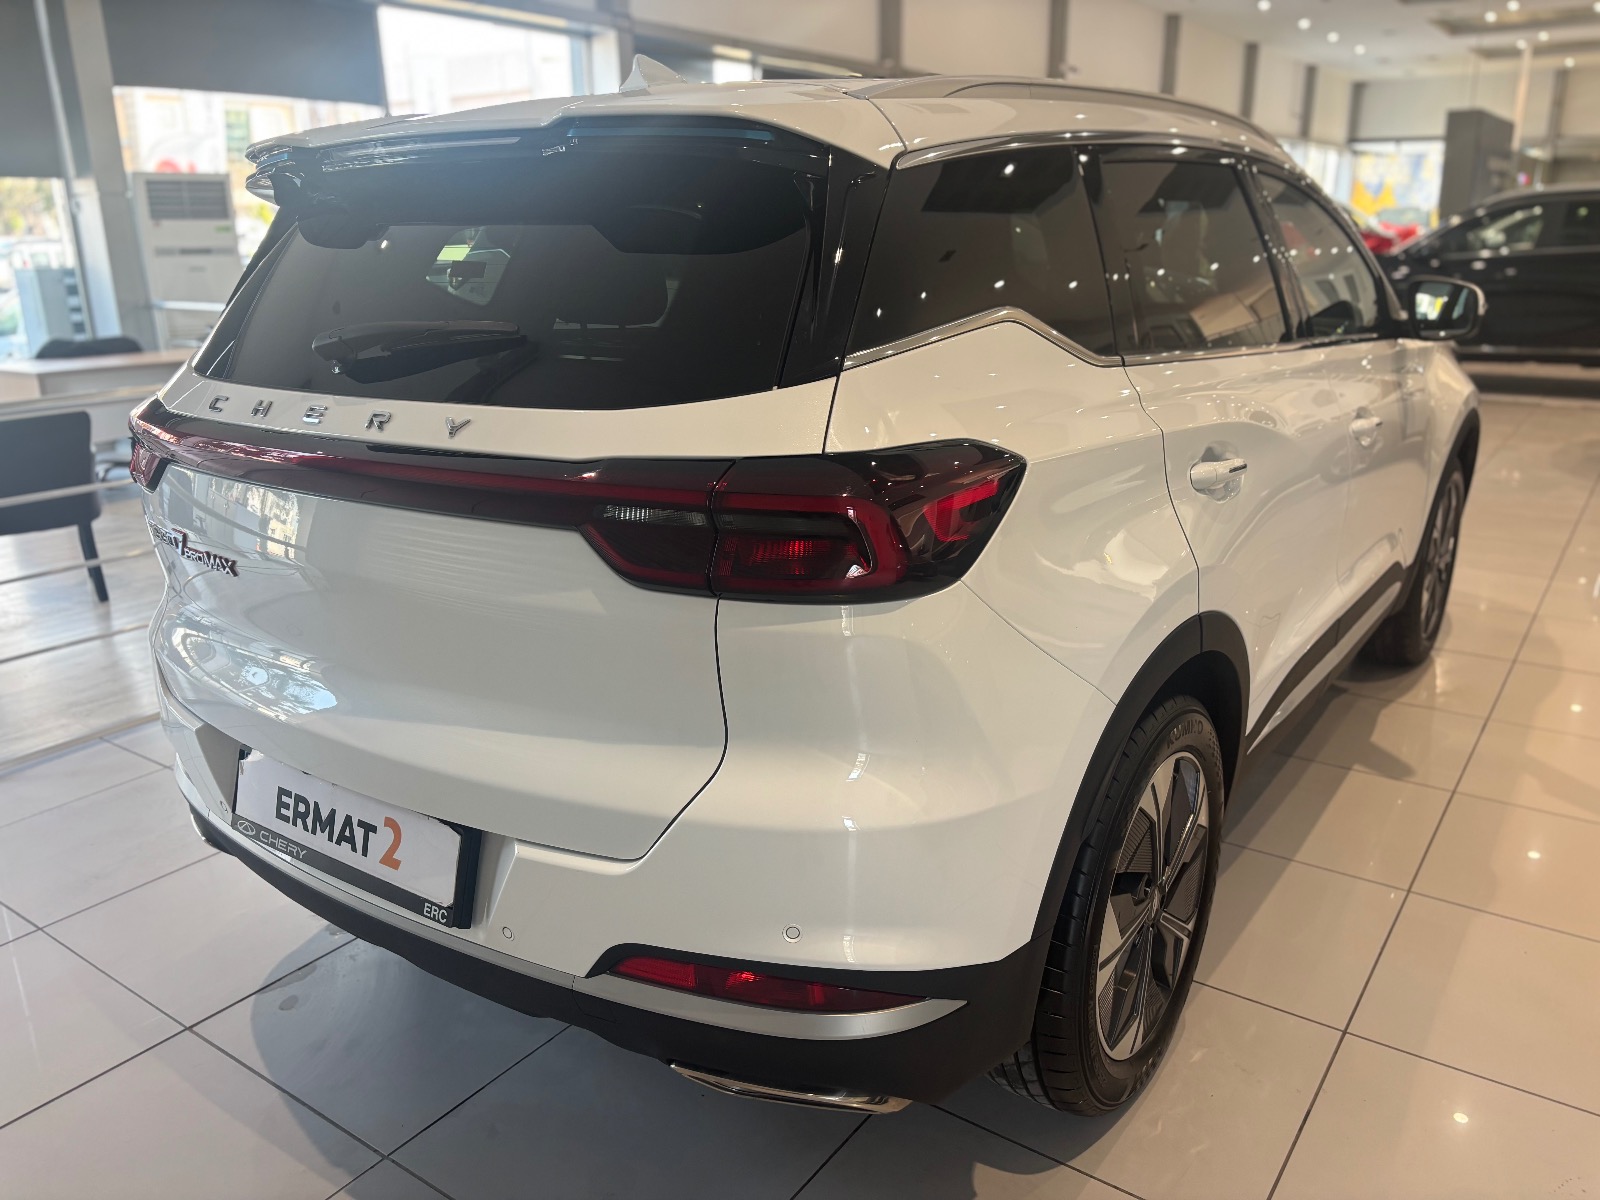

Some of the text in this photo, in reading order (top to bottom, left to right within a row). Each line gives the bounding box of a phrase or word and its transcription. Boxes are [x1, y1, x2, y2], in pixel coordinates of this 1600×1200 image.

[208, 394, 472, 438] CHERY
[259, 830, 308, 859] CHERY
[423, 902, 448, 924] ERC
